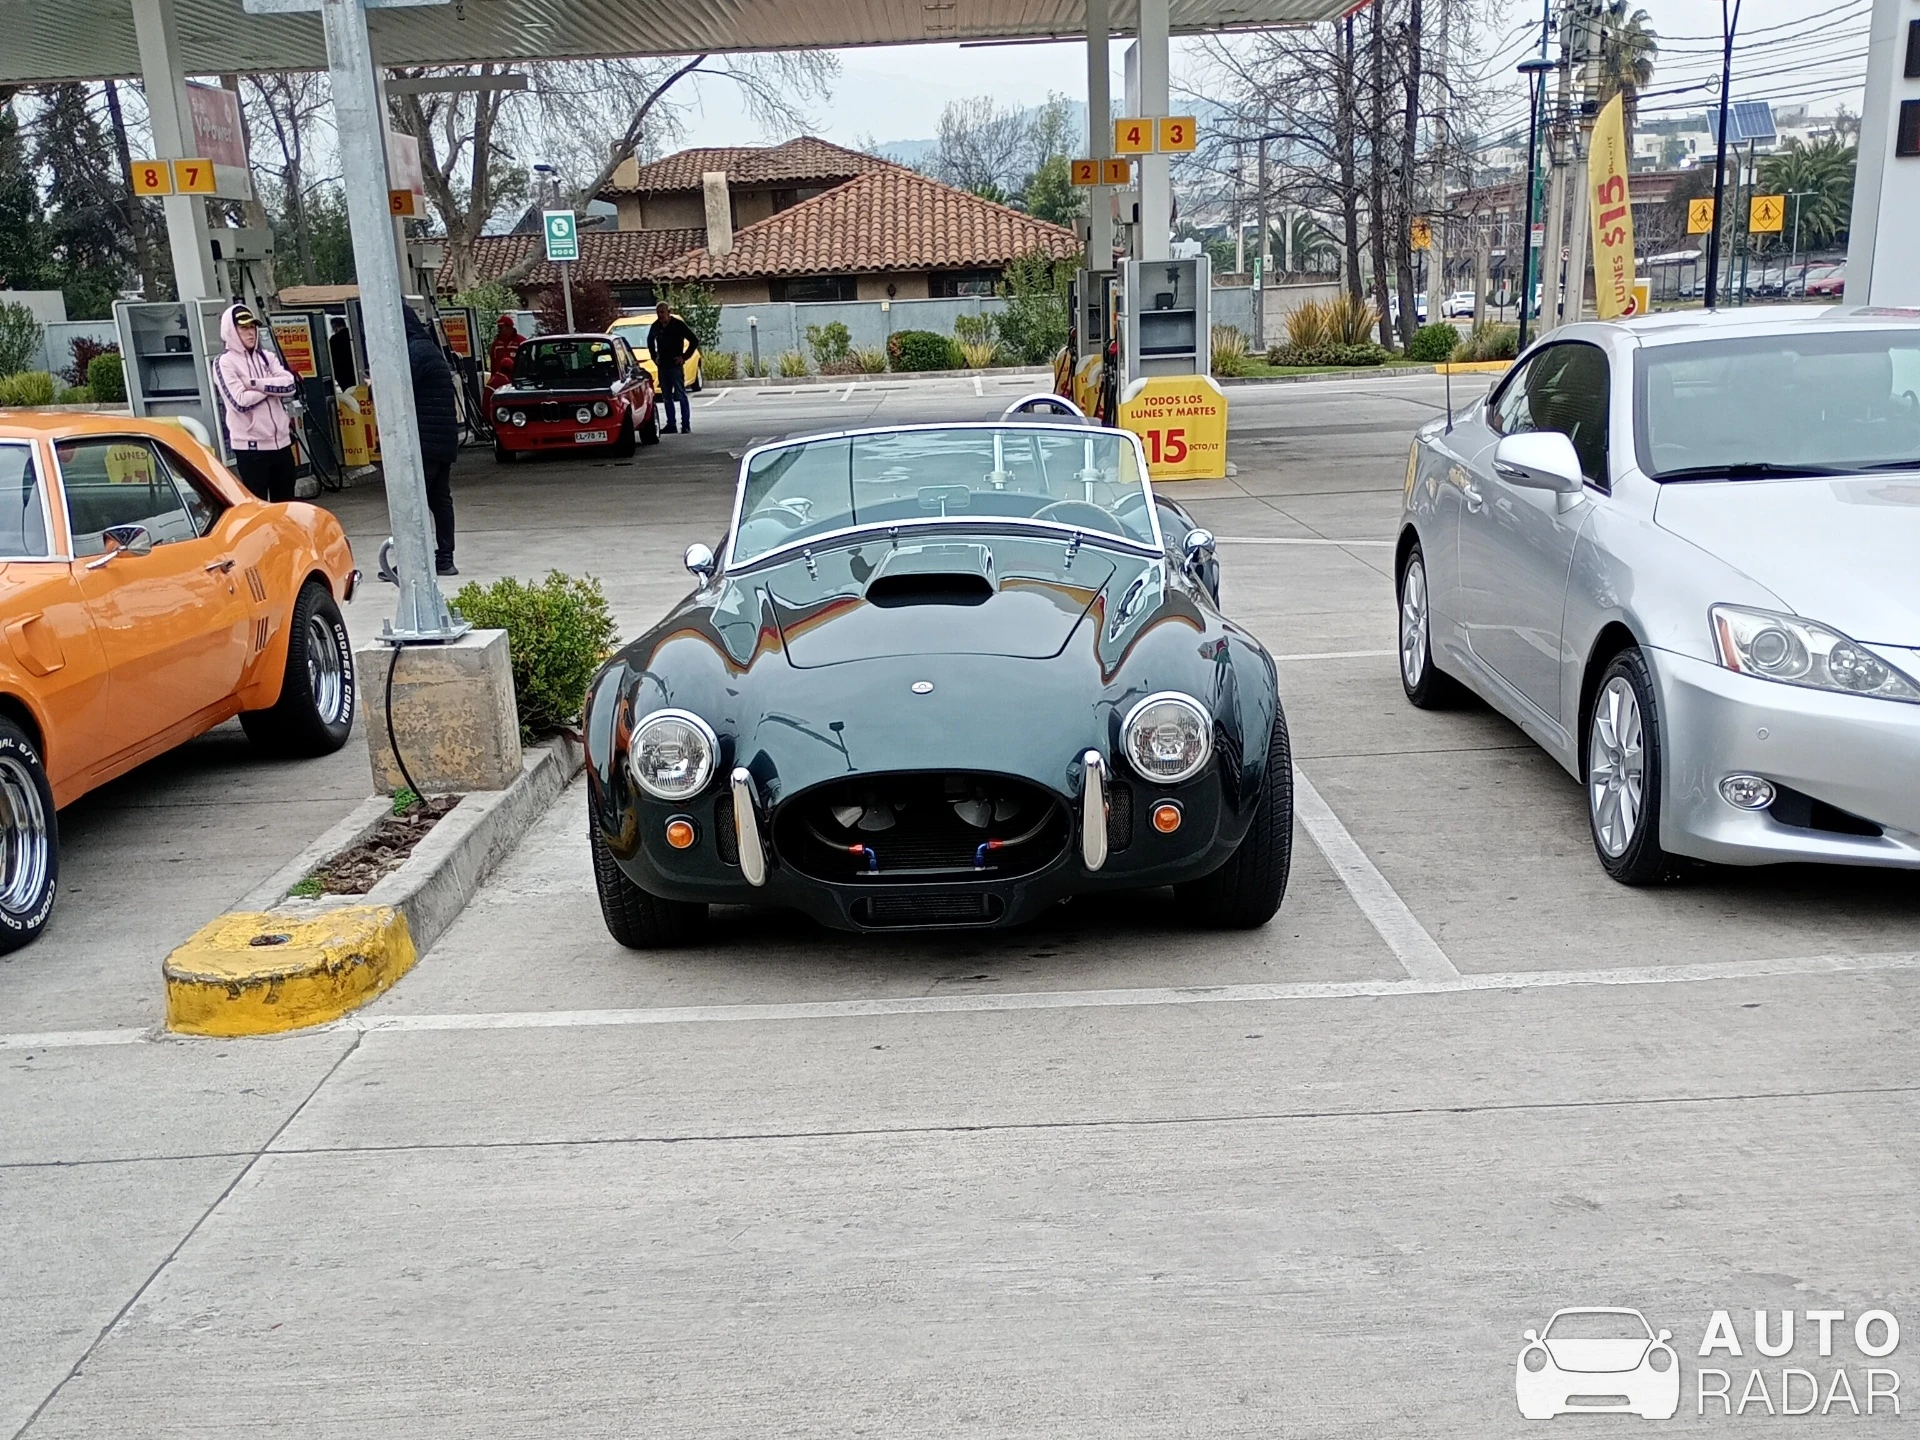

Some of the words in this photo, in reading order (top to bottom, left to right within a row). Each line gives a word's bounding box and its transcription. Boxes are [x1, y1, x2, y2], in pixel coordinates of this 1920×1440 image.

[1127, 127, 1141, 145] 4
[1170, 125, 1183, 144] 3
[144, 169, 159, 187] 8
[185, 168, 199, 186] 7
[1081, 165, 1091, 179] 2
[1112, 164, 1118, 178] 1
[393, 196, 403, 210] 5
[1597, 174, 1628, 248] $15
[1613, 255, 1626, 303] LUNES
[1144, 396, 1181, 406] TODOS
[1184, 395, 1203, 404] LOS
[1131, 409, 1164, 419] LUNES
[1166, 408, 1173, 417] Y
[1176, 407, 1217, 416] MARTES
[114, 451, 147, 462] LUNES
[334, 623, 352, 680] COOPER
[339, 684, 352, 724] COBRA
[26, 878, 56, 929] COOPER
